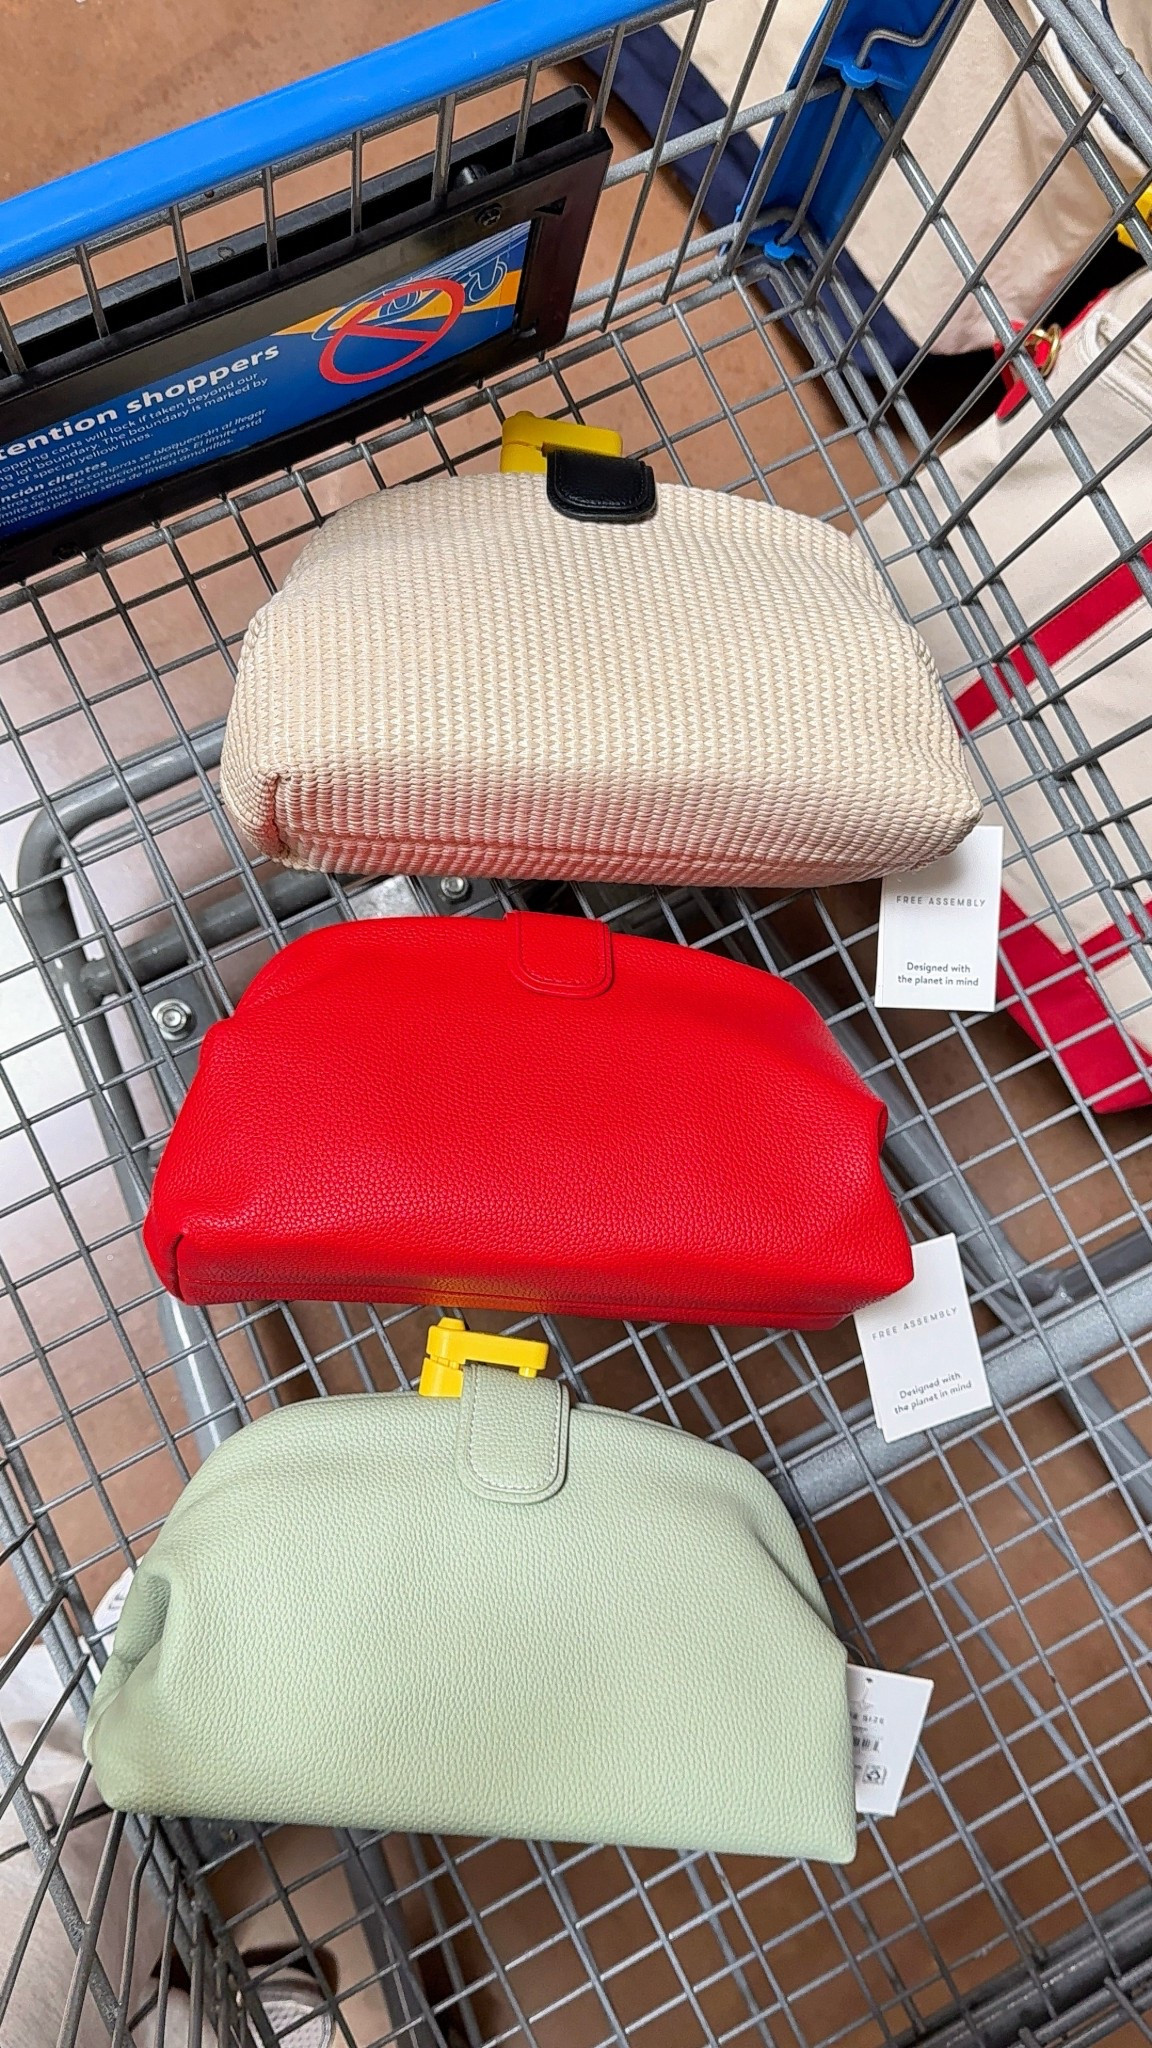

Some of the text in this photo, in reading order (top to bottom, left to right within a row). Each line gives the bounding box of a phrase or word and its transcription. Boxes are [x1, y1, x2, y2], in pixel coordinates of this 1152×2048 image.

[126, 345, 279, 414] shoppers
[0, 373, 258, 474] opping carts will lock if taken beyond our
[16, 466, 33, 476] lot
[36, 443, 100, 469] boundary.
[102, 433, 126, 446] The
[129, 409, 189, 436] boundary
[204, 384, 250, 408] marked
[253, 378, 268, 388] by
[18, 475, 30, 484] of
[33, 459, 76, 478] special
[78, 445, 118, 464] yellow
[122, 433, 154, 448] lines.
[32, 485, 68, 500] carros
[70, 478, 85, 487] de
[86, 460, 136, 480] compras
[140, 453, 151, 462] se
[222, 421, 232, 431] al
[235, 408, 267, 424] llegar
[48, 460, 108, 486] clientes
[30, 500, 44, 508] de
[47, 484, 90, 502] nuestro
[53, 498, 72, 510] por
[76, 488, 98, 499] una
[101, 478, 126, 491] serie
[128, 471, 142, 481] de
[896, 896, 986, 908] FREE ASSEMBLY
[898, 975, 979, 986] the planet in mind
[906, 962, 970, 974] Designed with
[872, 1306, 958, 1341] FREE ASSEMBLY
[894, 1380, 972, 1414] the planet in mind
[899, 1372, 961, 1399] Designed with
